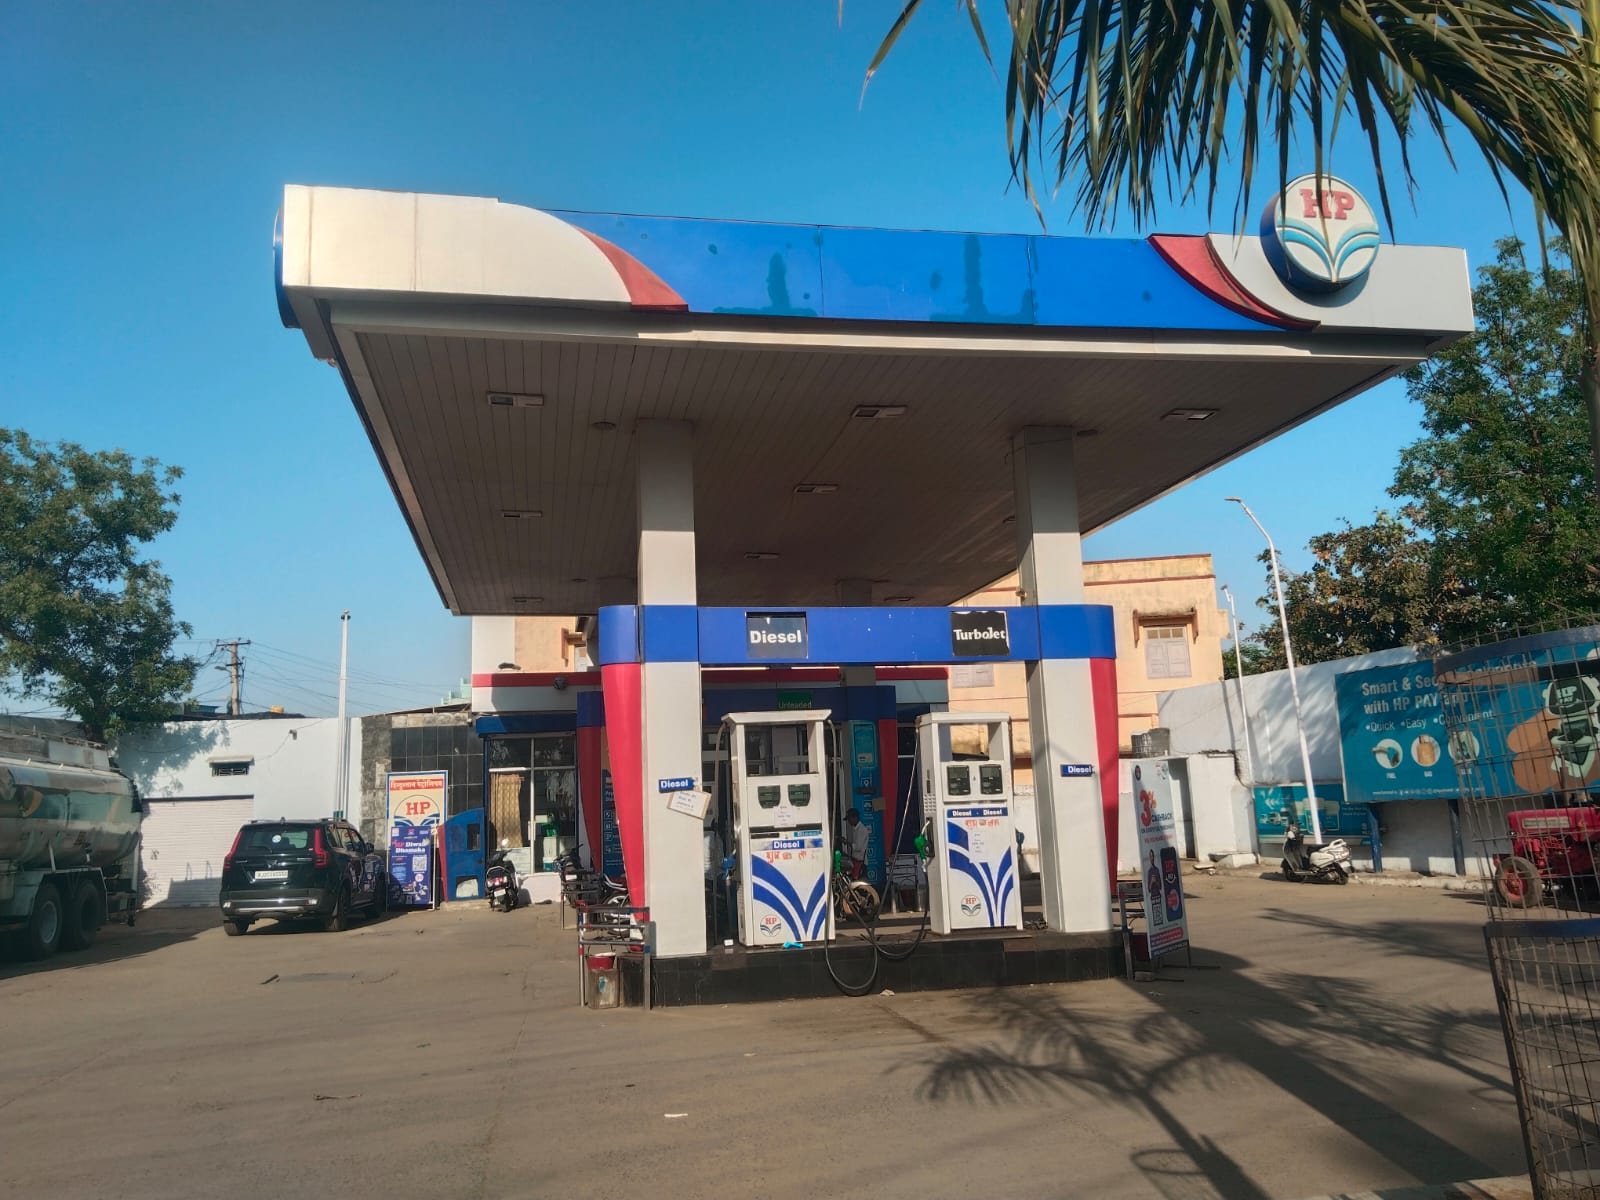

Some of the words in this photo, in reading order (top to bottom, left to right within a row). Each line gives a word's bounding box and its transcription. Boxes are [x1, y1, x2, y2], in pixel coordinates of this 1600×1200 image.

[1299, 189, 1354, 220] HP
[750, 630, 801, 643] Diesel
[1362, 680, 1398, 696] Smart
[1402, 677, 1411, 690] &
[1364, 700, 1389, 714] with
[1393, 697, 1410, 711] HP
[1415, 693, 1438, 708] PAY
[660, 779, 688, 788] Diesel
[406, 801, 430, 815] HP
[774, 841, 800, 849] Diesel
[965, 897, 977, 905] HP
[765, 917, 777, 925] HP
